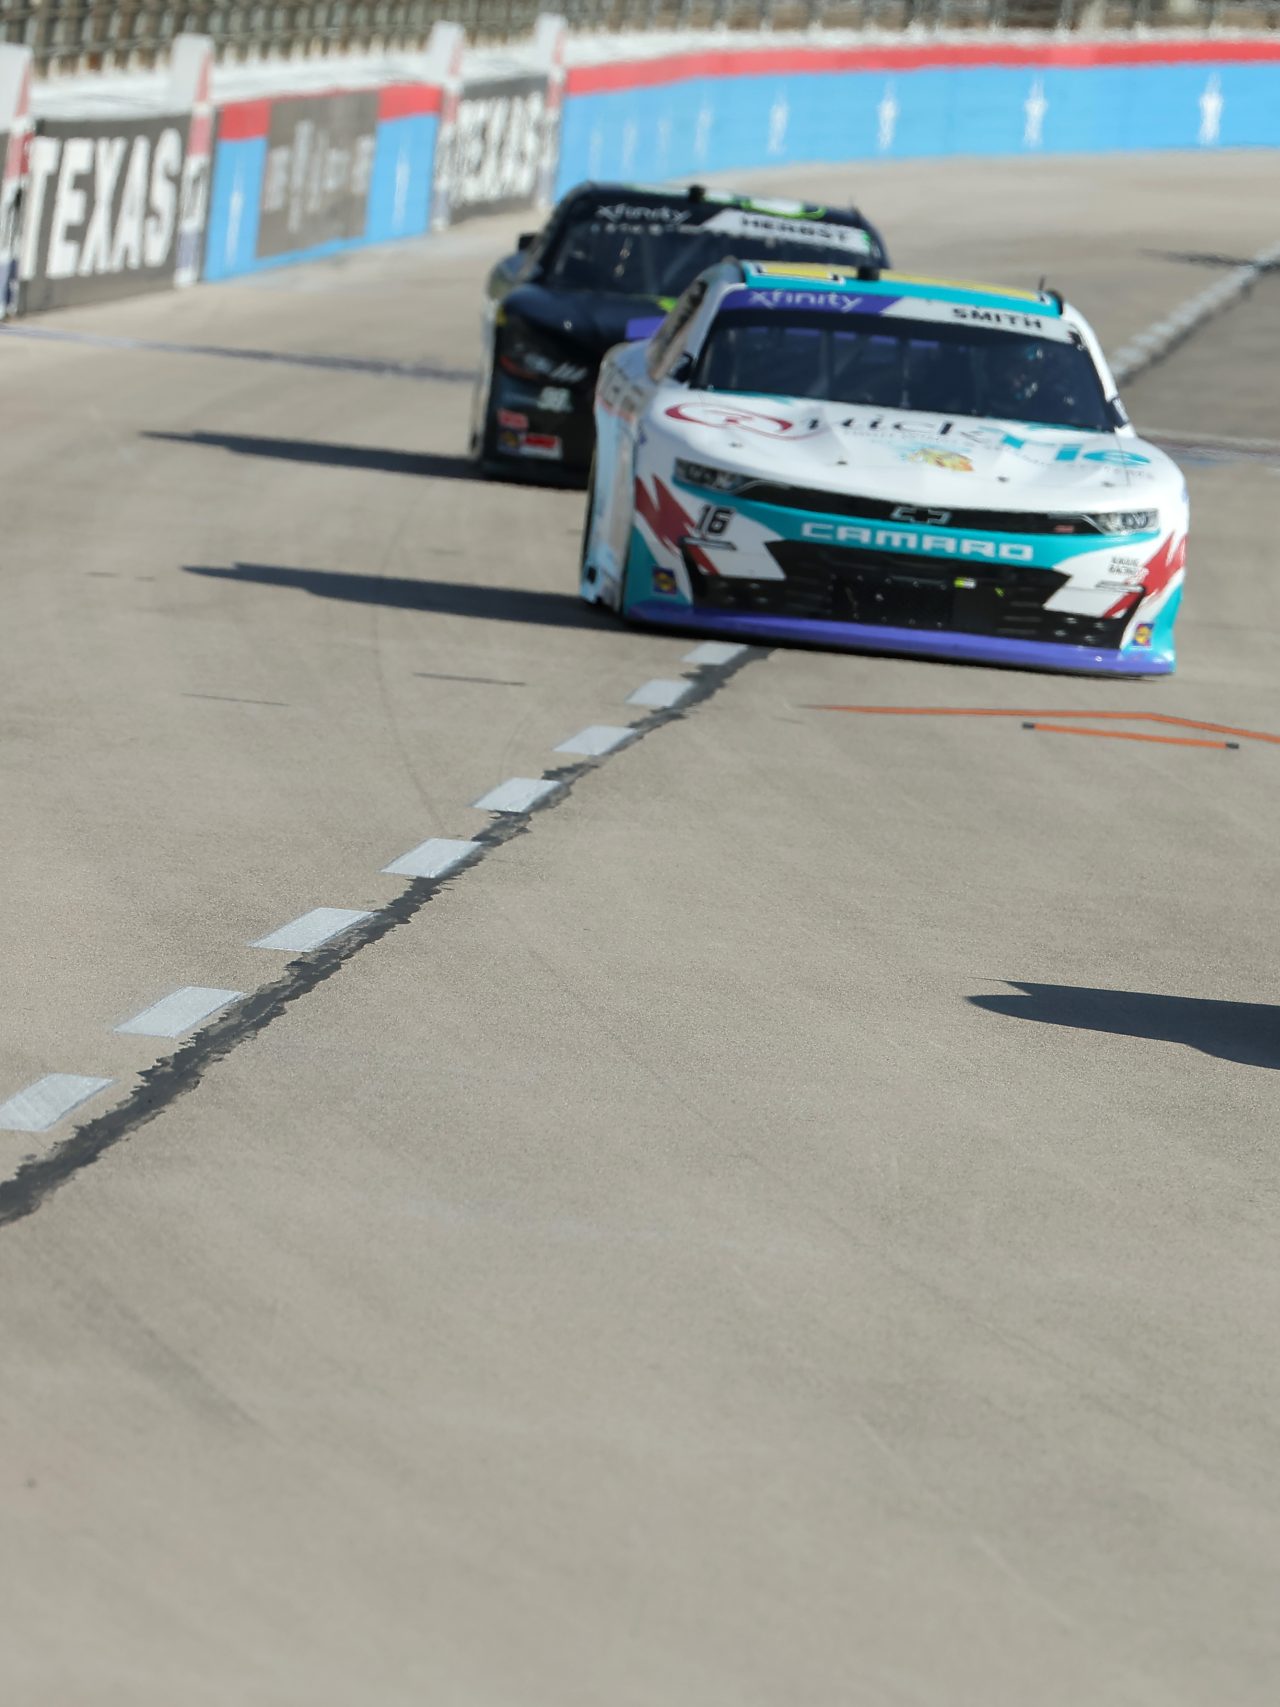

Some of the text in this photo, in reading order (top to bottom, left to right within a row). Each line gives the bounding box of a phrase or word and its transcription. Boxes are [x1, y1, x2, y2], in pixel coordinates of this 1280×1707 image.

[20, 127, 182, 281] TEXAS
[751, 289, 863, 314] xfinity
[952, 307, 1043, 330] SMITH
[697, 504, 735, 535] 16
[801, 522, 1034, 561] CAMARO
